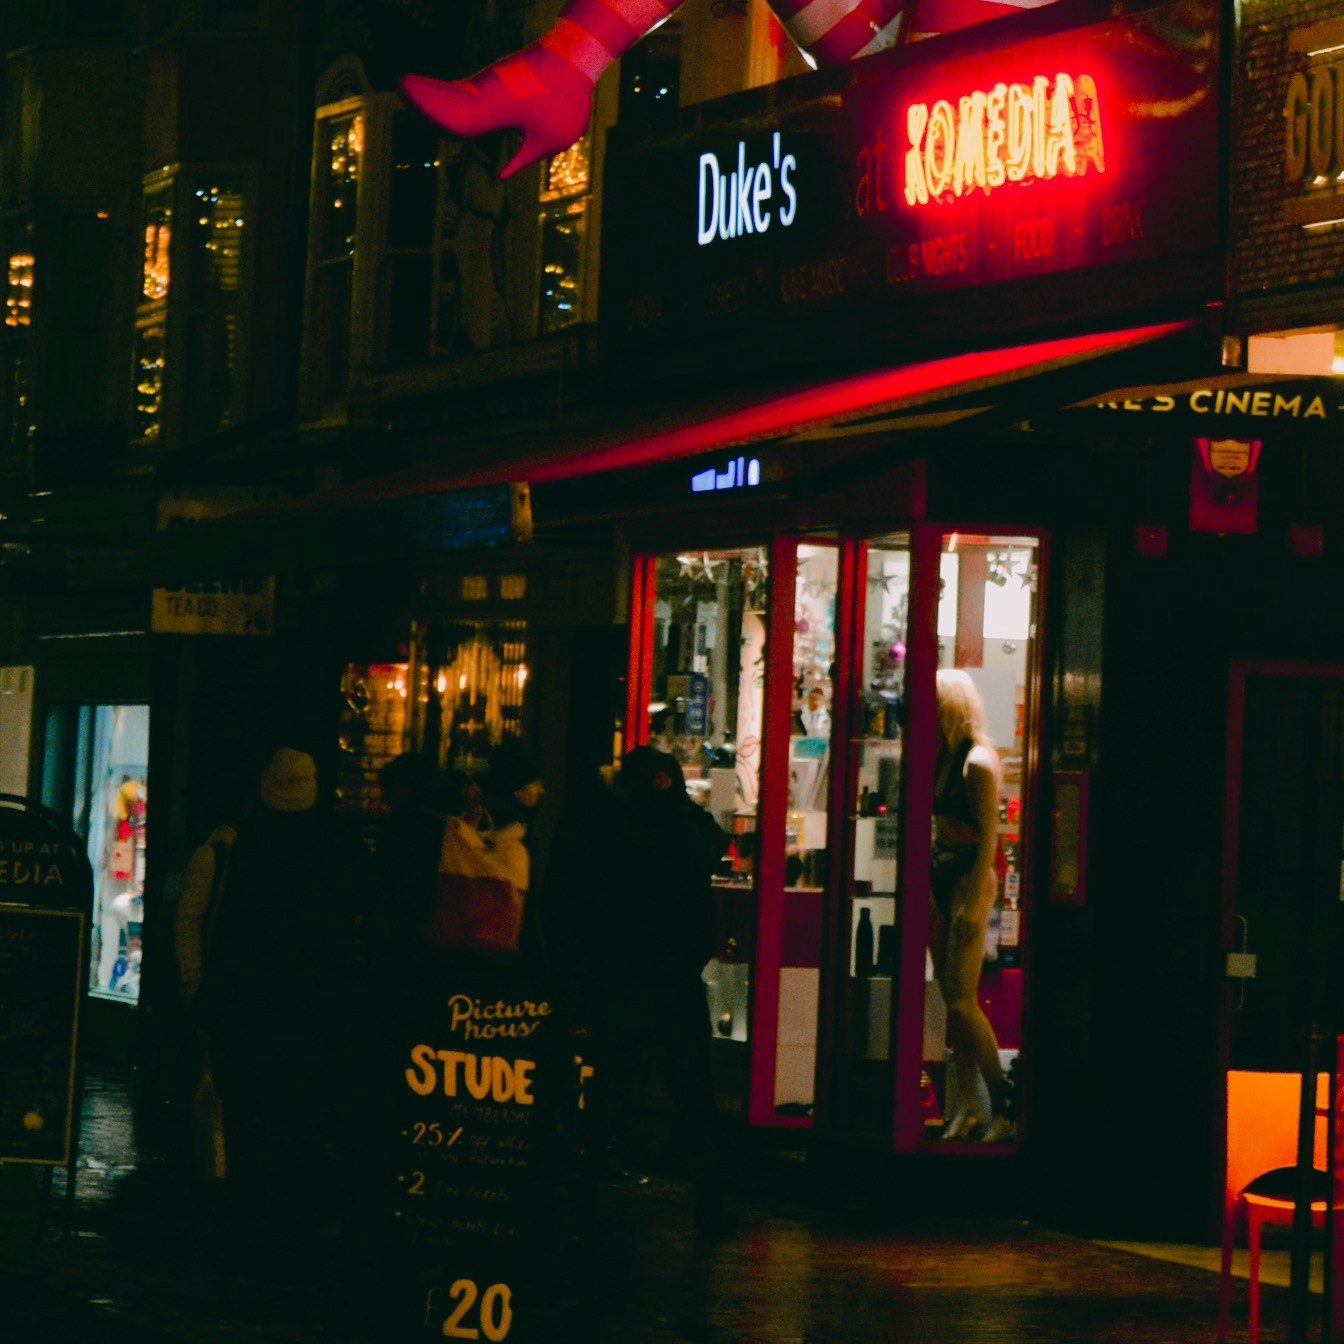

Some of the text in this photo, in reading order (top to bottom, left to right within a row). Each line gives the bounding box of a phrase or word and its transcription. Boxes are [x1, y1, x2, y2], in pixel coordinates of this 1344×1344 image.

[904, 72, 1078, 206] KOMEDIA
[697, 131, 797, 245] Duke's
[1014, 215, 1054, 261] FOOD
[1190, 390, 1327, 419] CINEMA
[12, 841, 34, 854] UP
[40, 842, 60, 855] AT
[447, 993, 552, 1032] Picture
[405, 1042, 538, 1106] STUDE
